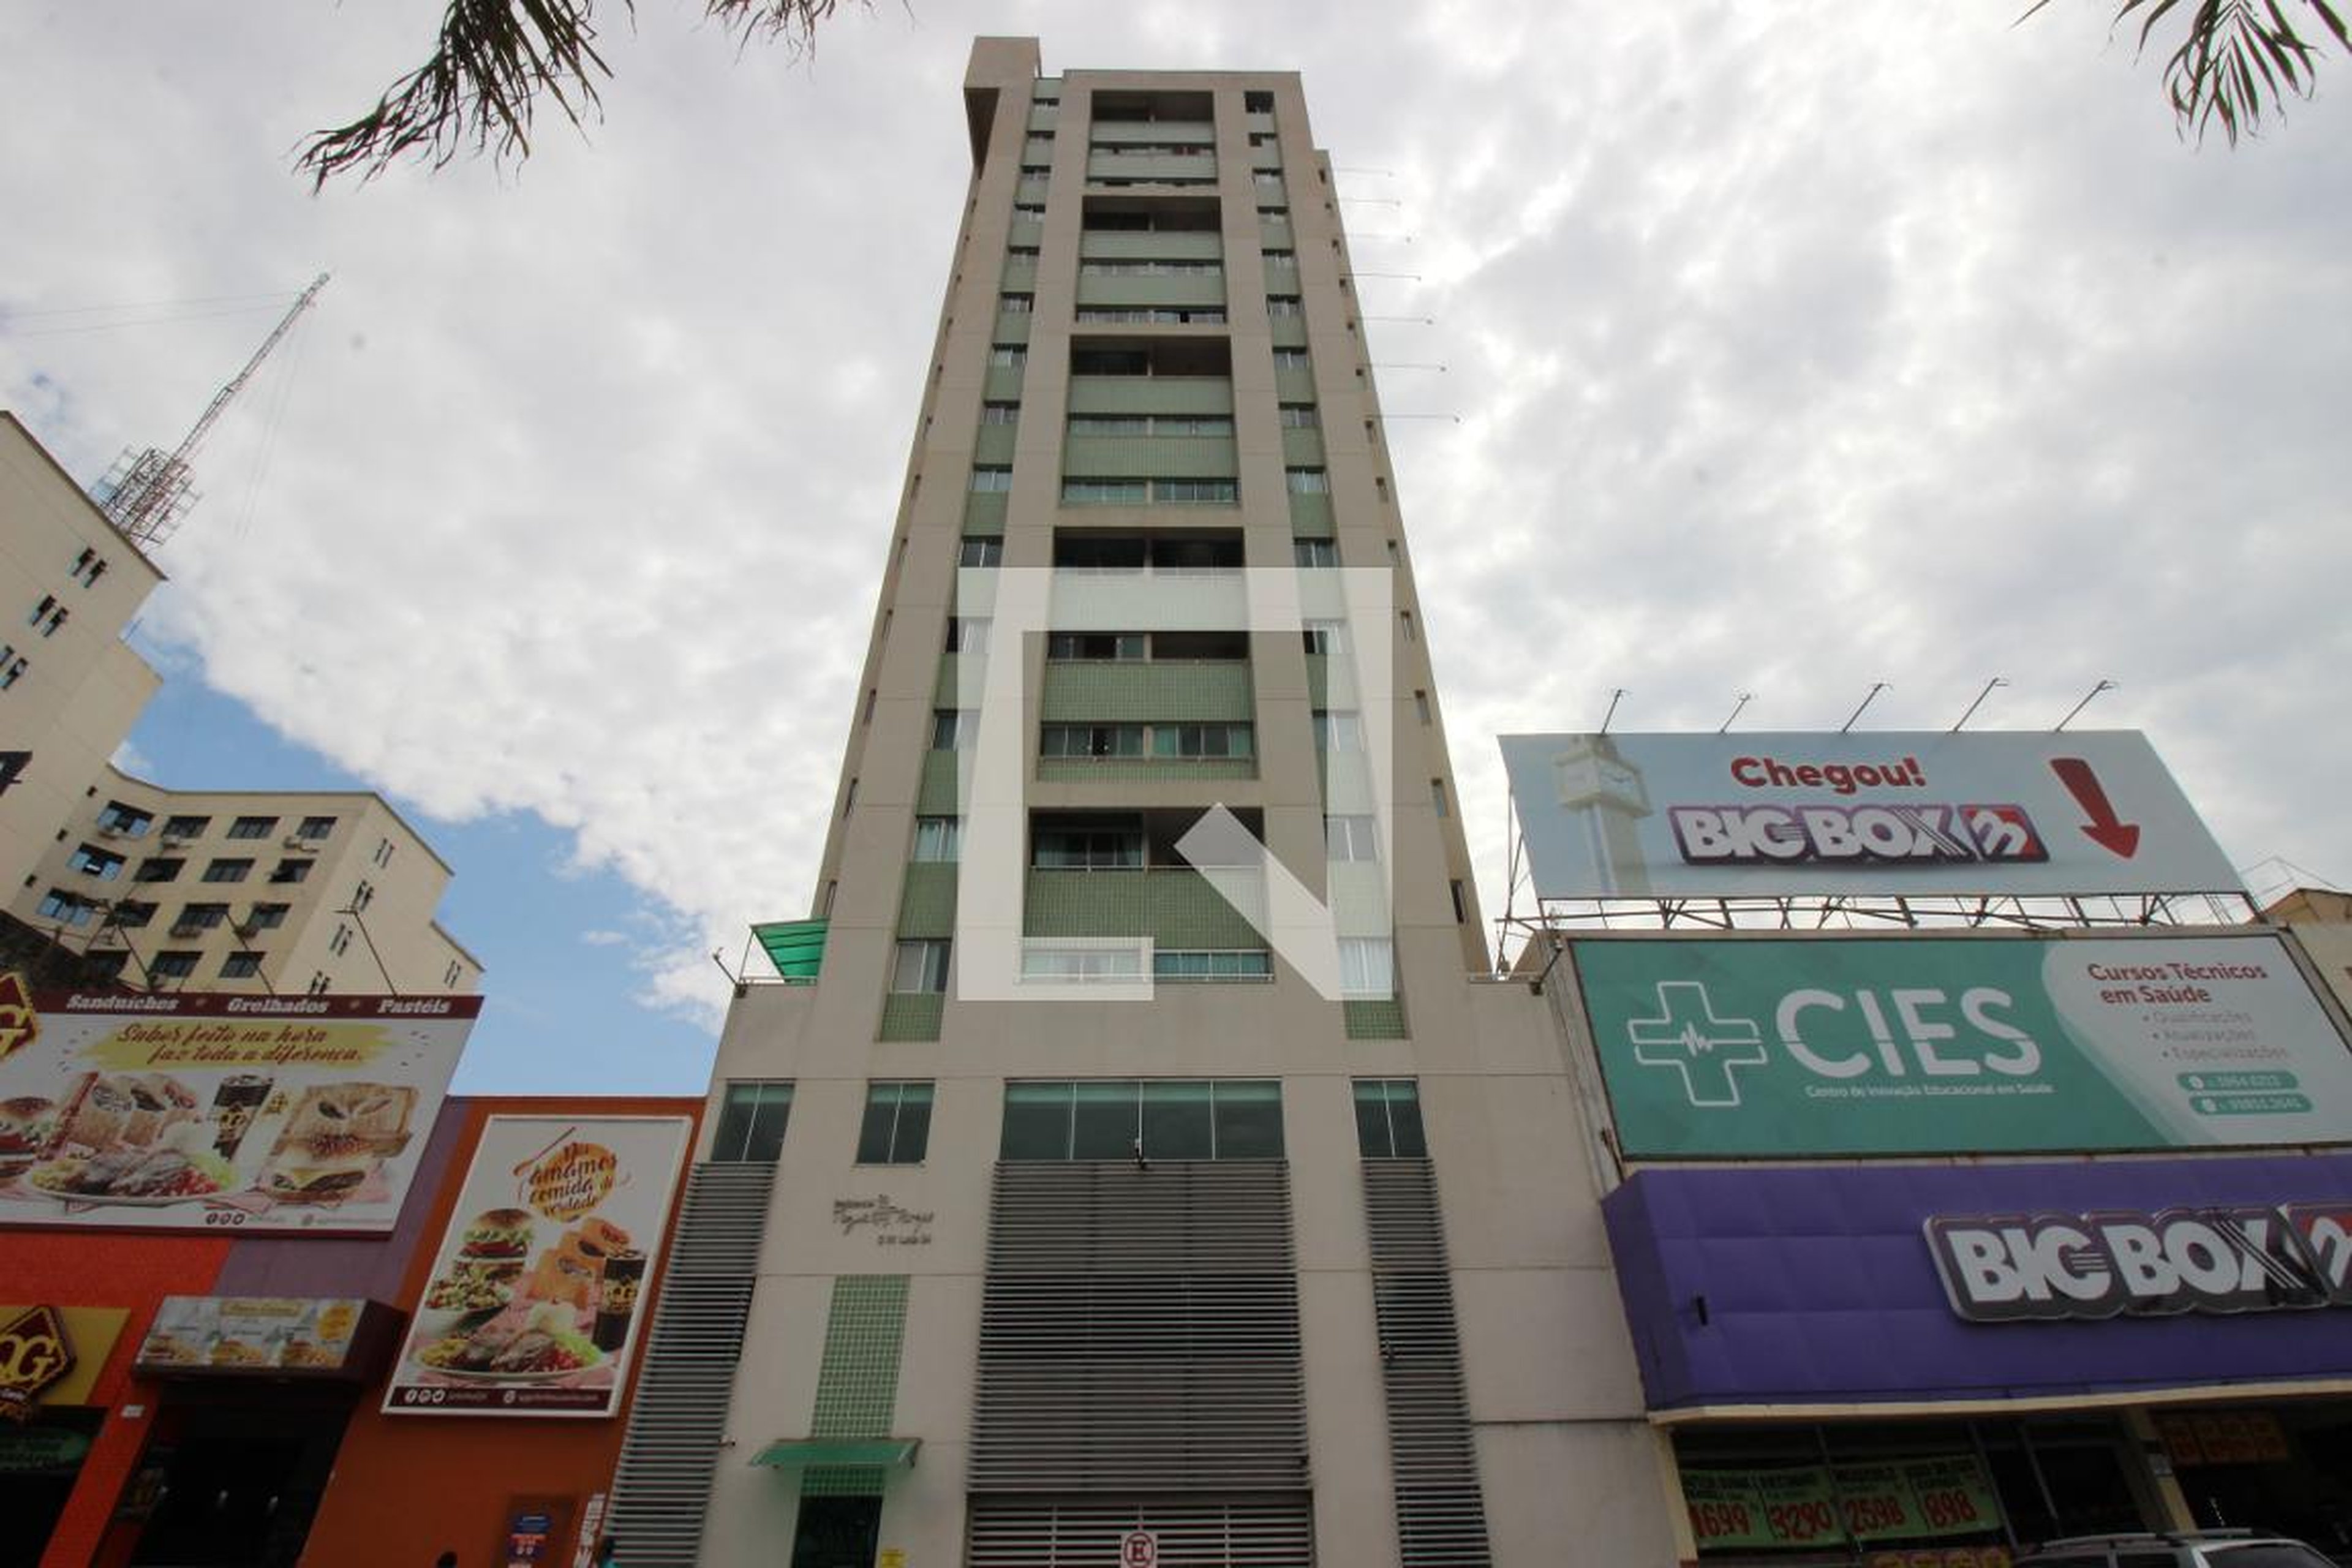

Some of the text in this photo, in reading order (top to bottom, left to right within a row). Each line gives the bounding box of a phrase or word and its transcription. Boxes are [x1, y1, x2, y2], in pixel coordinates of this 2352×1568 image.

[1731, 757, 1926, 794] Chegou!
[2088, 963, 2268, 980] Cursos Técnicos
[2101, 985, 2212, 1003] em Saúde
[116, 1023, 182, 1043] Sabor
[181, 1024, 236, 1046] feito
[275, 1025, 328, 1043] hora
[1776, 989, 2040, 1077] CIES
[146, 1044, 190, 1065] faz
[193, 1045, 239, 1061] toda
[529, 1177, 594, 1204] comida
[1945, 1219, 2308, 1303] BIG BOX
